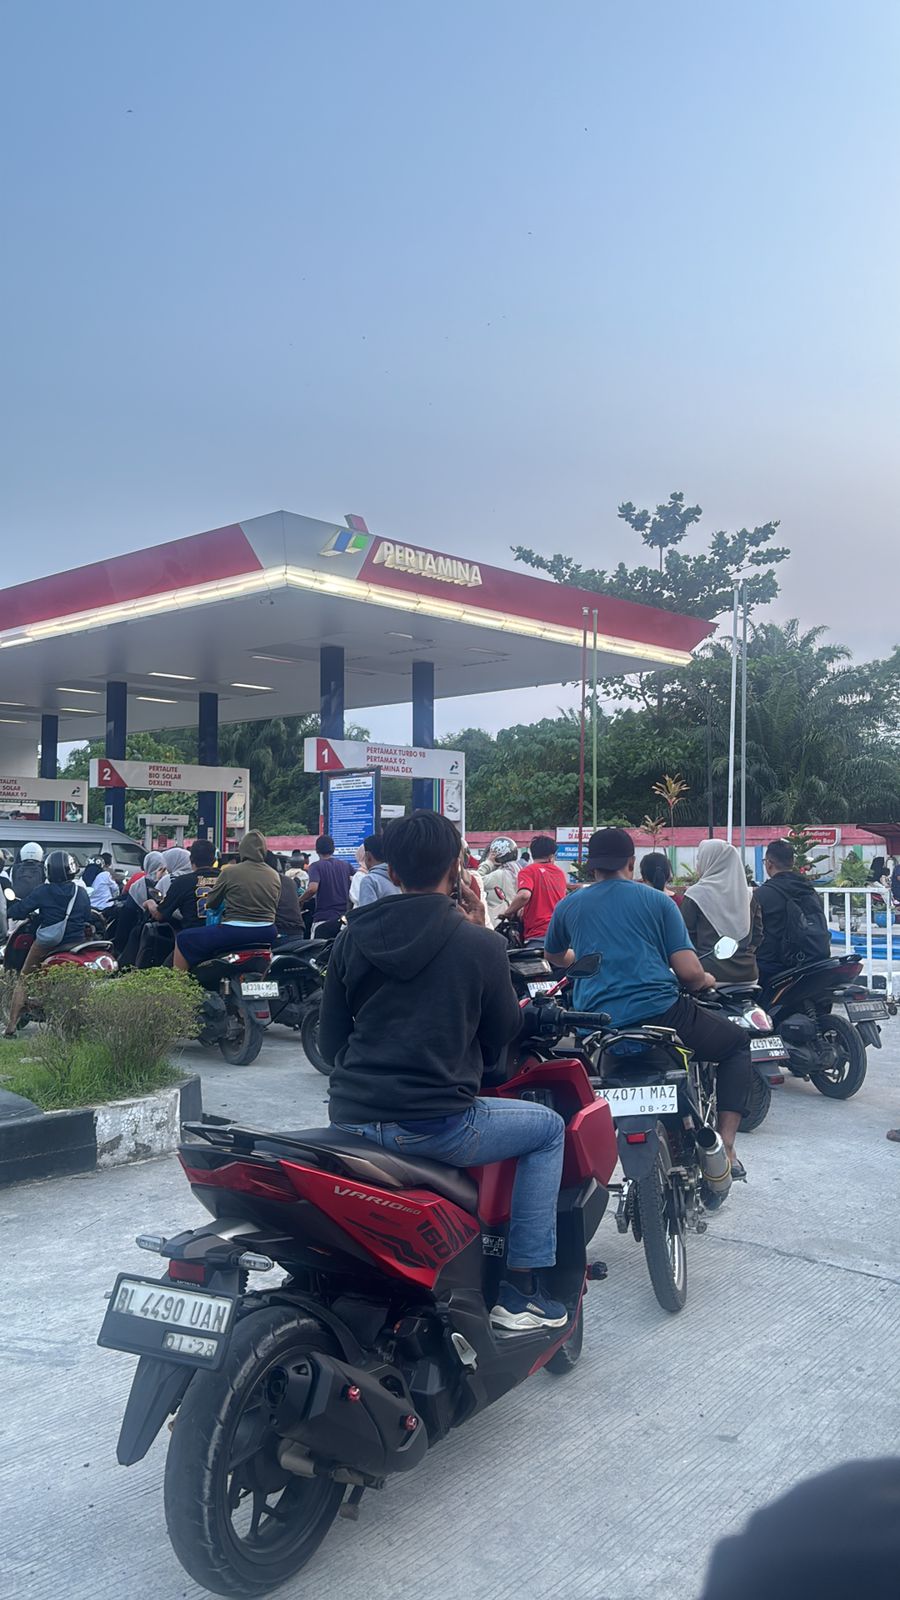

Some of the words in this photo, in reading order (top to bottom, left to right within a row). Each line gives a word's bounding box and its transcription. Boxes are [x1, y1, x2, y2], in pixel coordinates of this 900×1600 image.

[373, 541, 482, 587] PERTAMINA
[321, 748, 329, 763] 1
[366, 746, 397, 755] PERTAMAX
[398, 749, 417, 758] TURBO
[366, 755, 397, 764] PERTAMAX
[102, 767, 112, 781] 2
[148, 765, 178, 773] PERTALITE
[148, 779, 172, 787] DEXLITE
[650, 1086, 676, 1099] MAZ
[334, 1185, 403, 1210] VARIO
[416, 1220, 450, 1259] 160
[115, 1287, 135, 1314] BL
[140, 1292, 185, 1322] 4490
[190, 1301, 227, 1331] UAN
